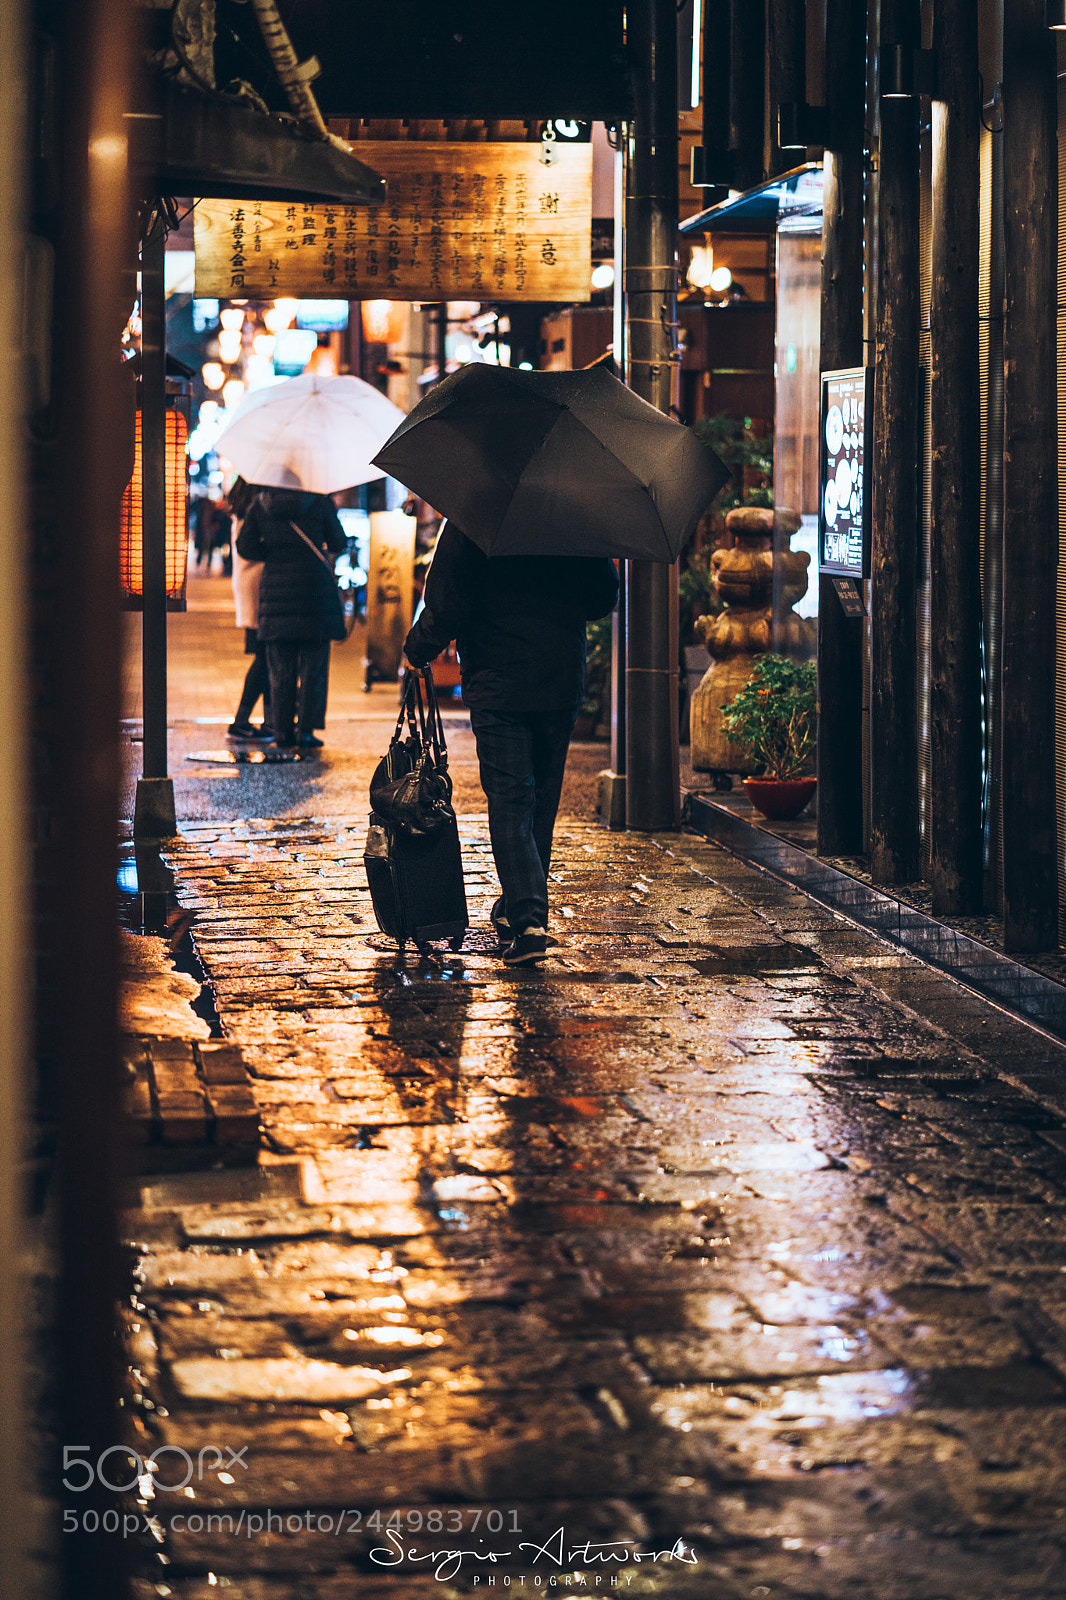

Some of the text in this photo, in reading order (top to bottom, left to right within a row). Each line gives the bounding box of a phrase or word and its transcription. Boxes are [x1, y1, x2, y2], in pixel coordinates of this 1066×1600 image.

[229, 207, 249, 289] 法善寺会一同
